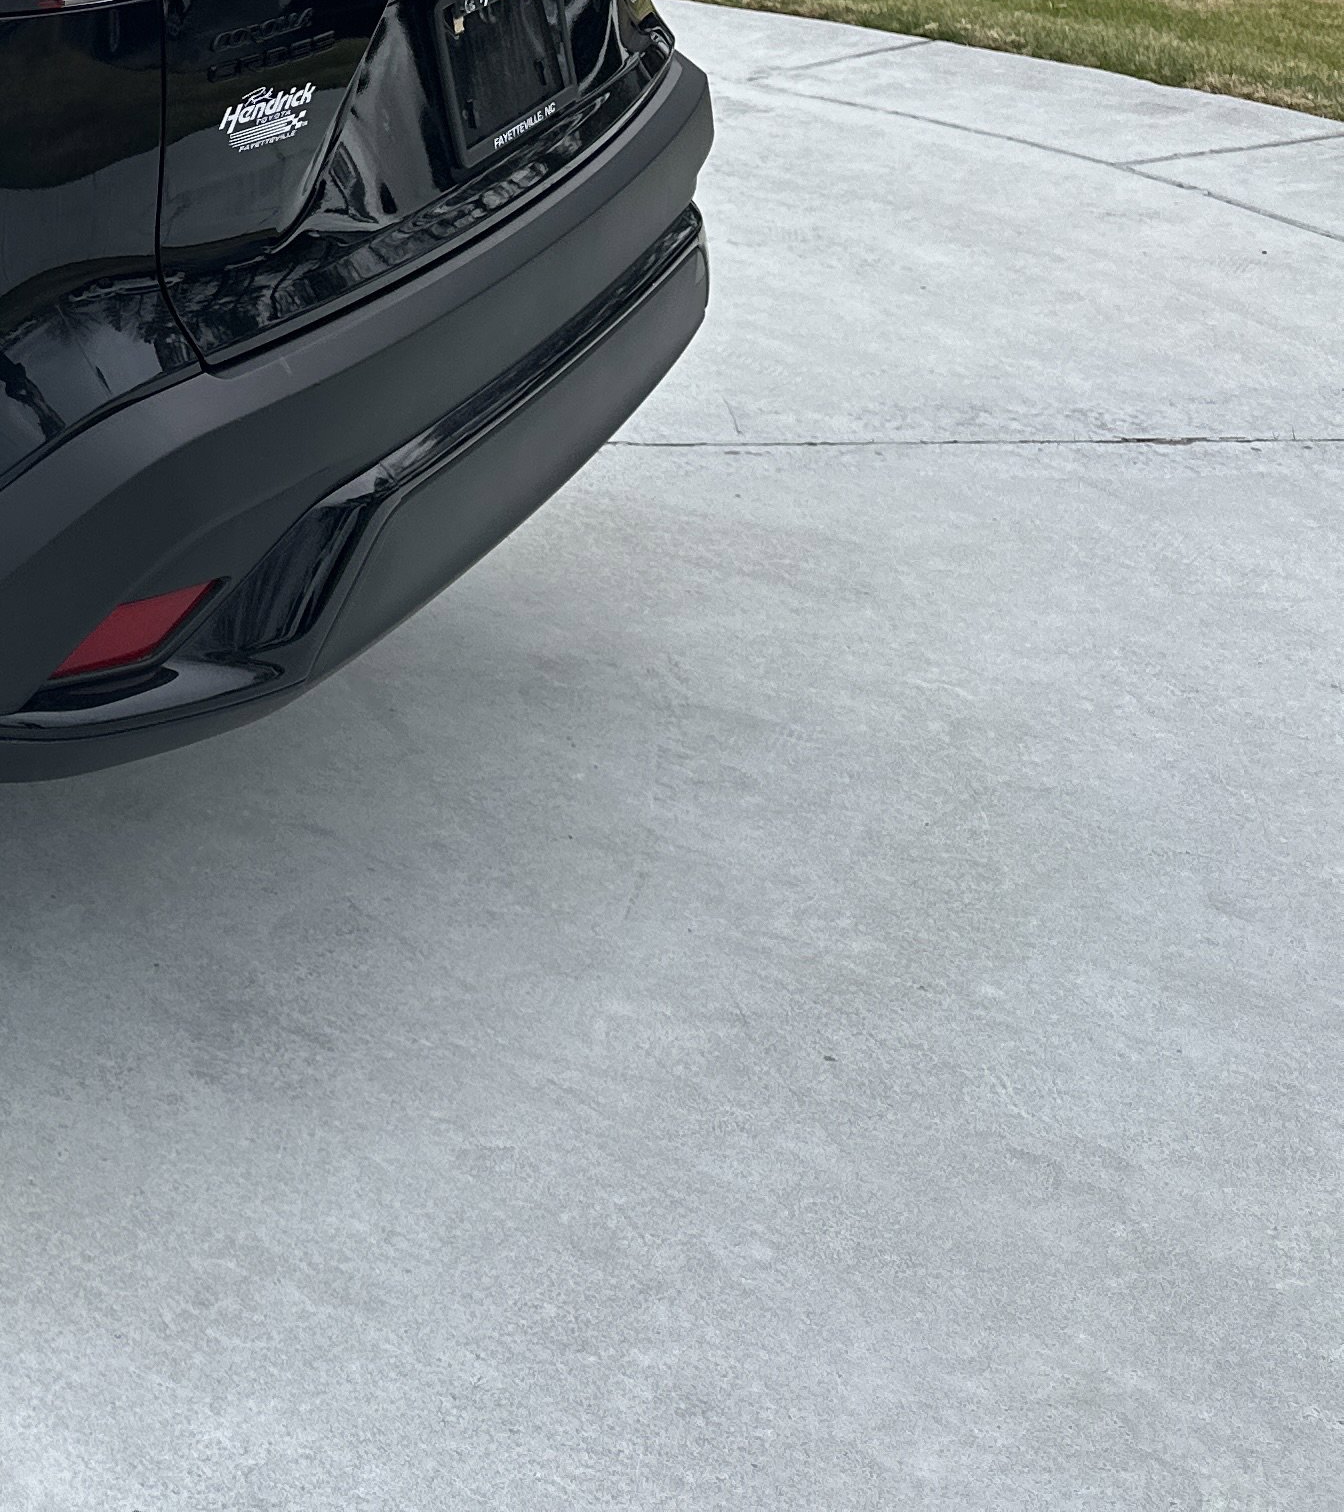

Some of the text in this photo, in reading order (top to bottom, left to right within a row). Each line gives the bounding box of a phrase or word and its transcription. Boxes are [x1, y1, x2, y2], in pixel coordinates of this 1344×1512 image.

[207, 30, 335, 83] CROSS
[218, 82, 316, 135] Hendrick
[255, 109, 292, 126] TOYOTA
[544, 101, 556, 118] NC
[238, 129, 298, 153] FAYETTEVILLE
